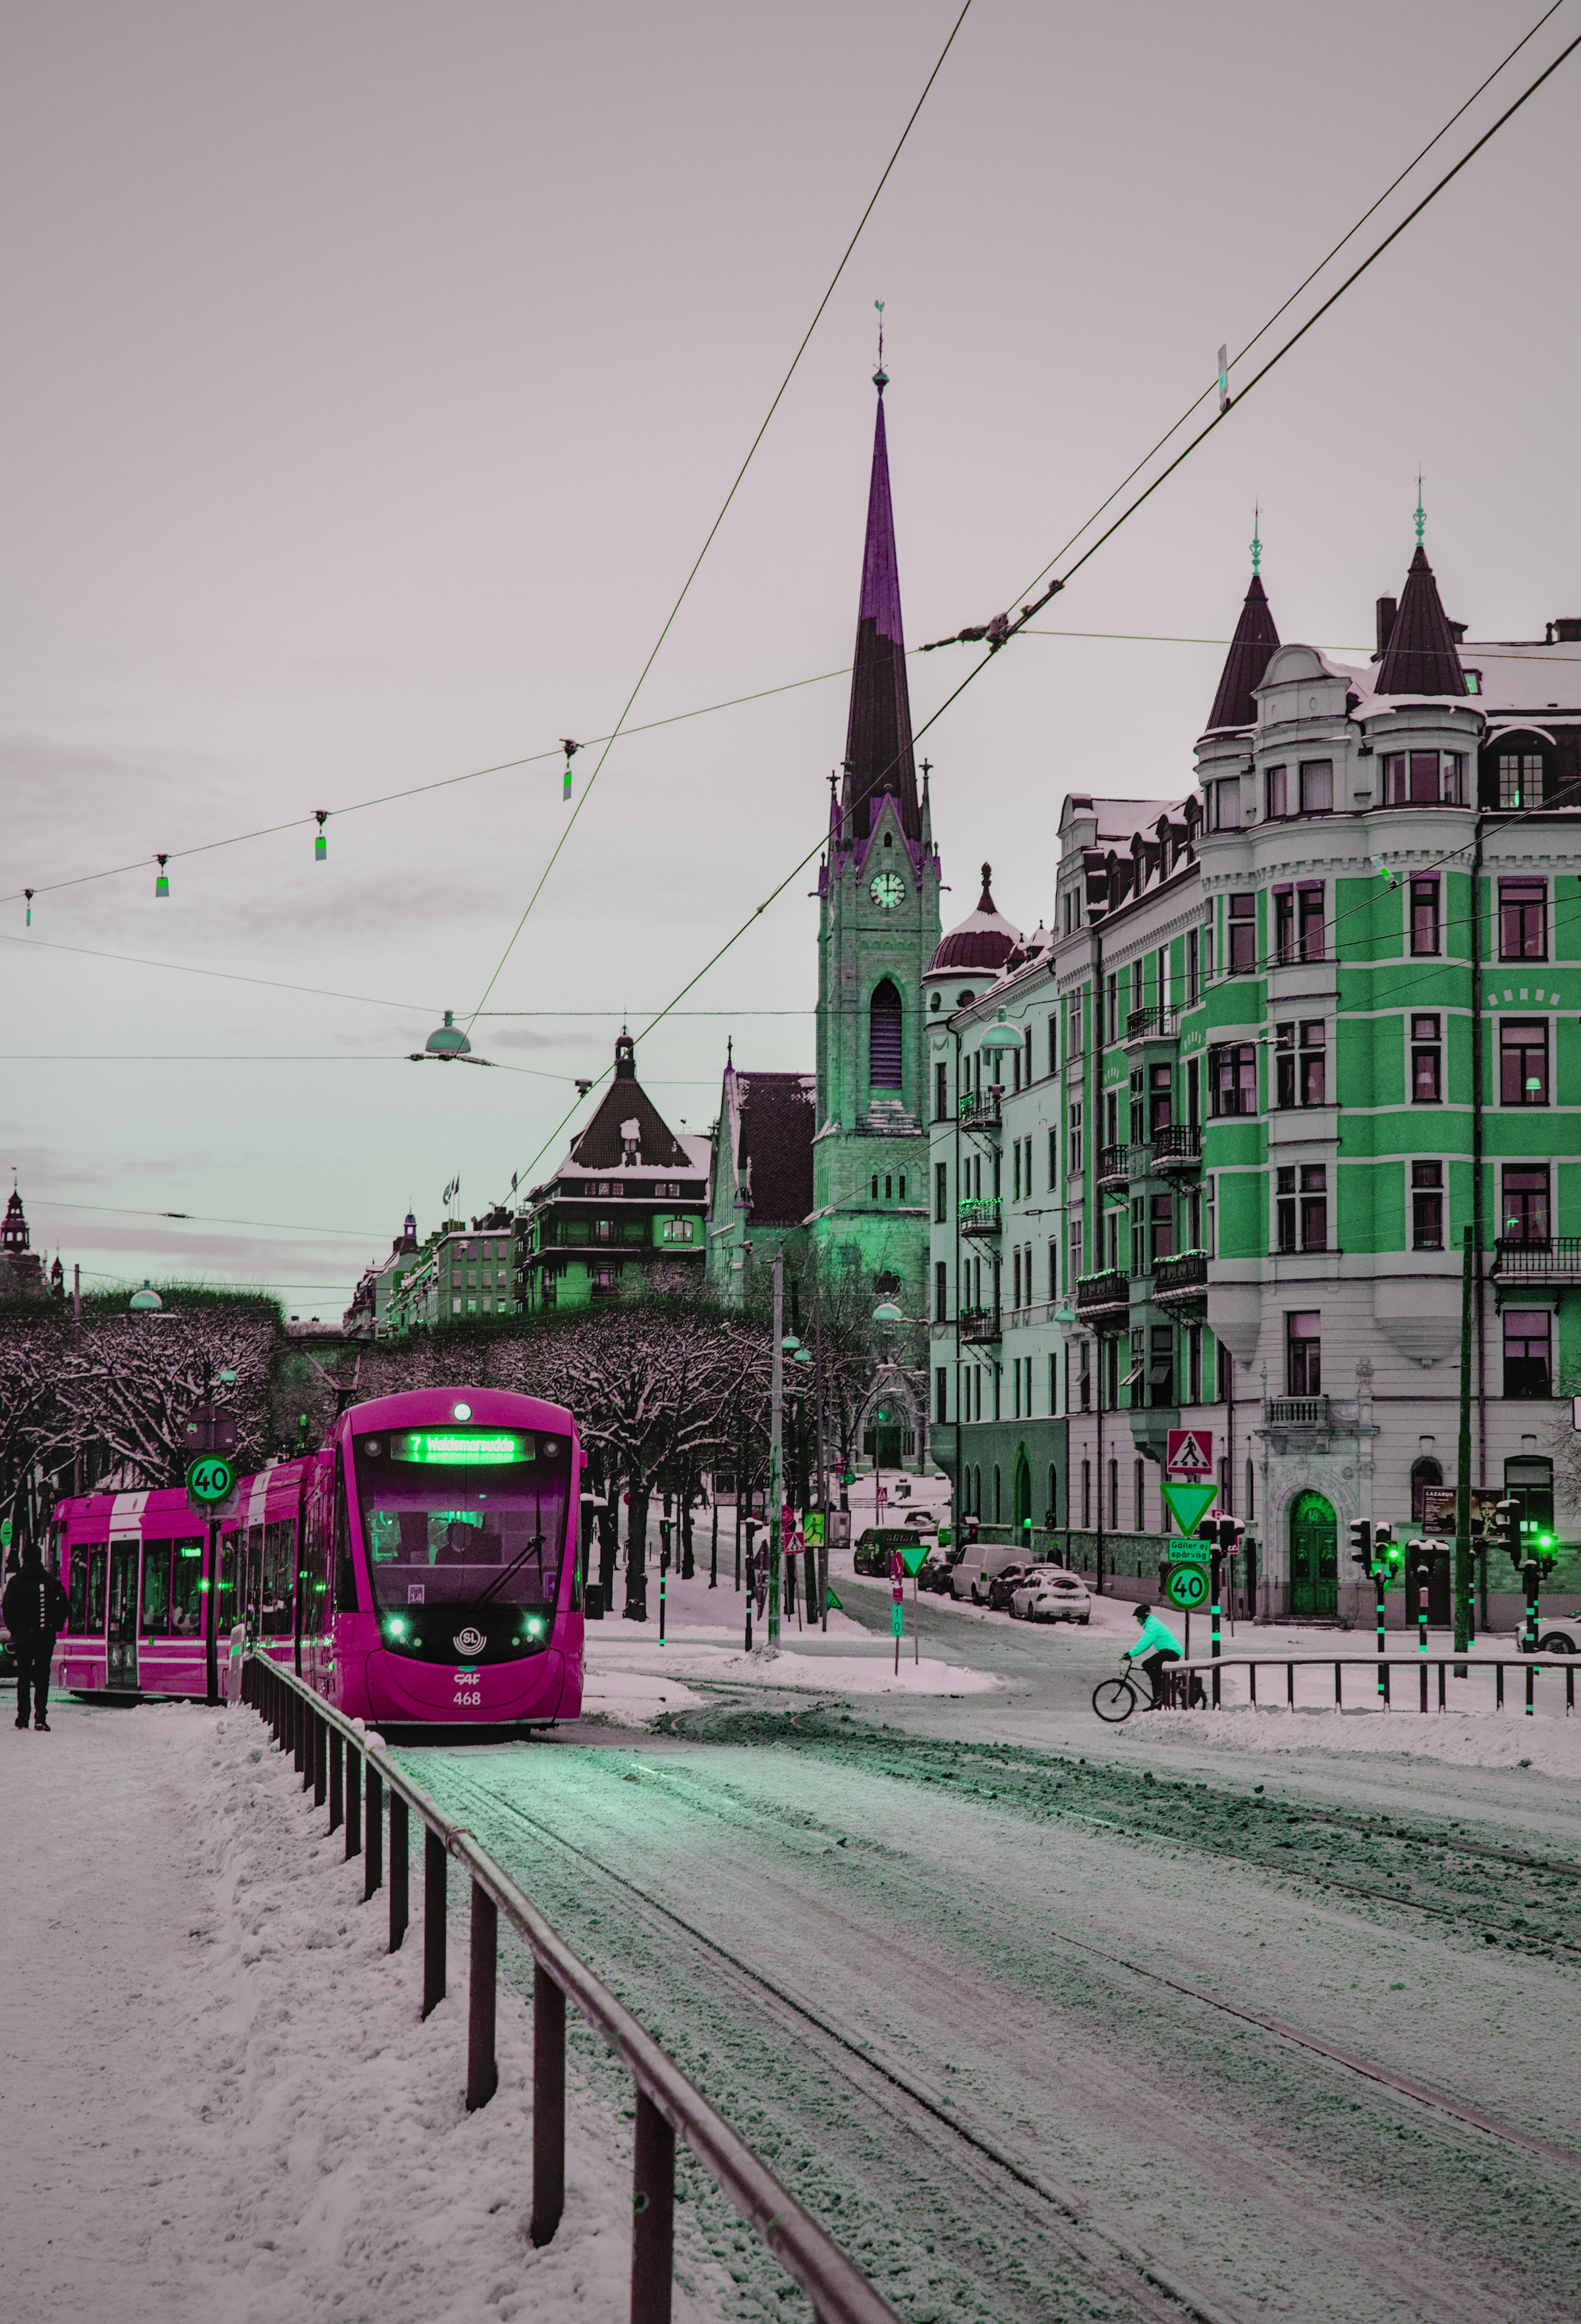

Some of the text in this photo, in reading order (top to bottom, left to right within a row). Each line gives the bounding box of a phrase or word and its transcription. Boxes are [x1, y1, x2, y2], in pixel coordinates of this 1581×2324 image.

[411, 1437, 515, 1452] 7 Waldemarsudde
[195, 1468, 227, 1491] 40
[1171, 1551, 1206, 1560] spårväg
[1173, 1576, 1203, 1598] 40
[410, 1593, 422, 1602] 14
[462, 1632, 478, 1644] SL
[453, 1674, 481, 1685] CAF
[453, 1692, 482, 1705] 468
